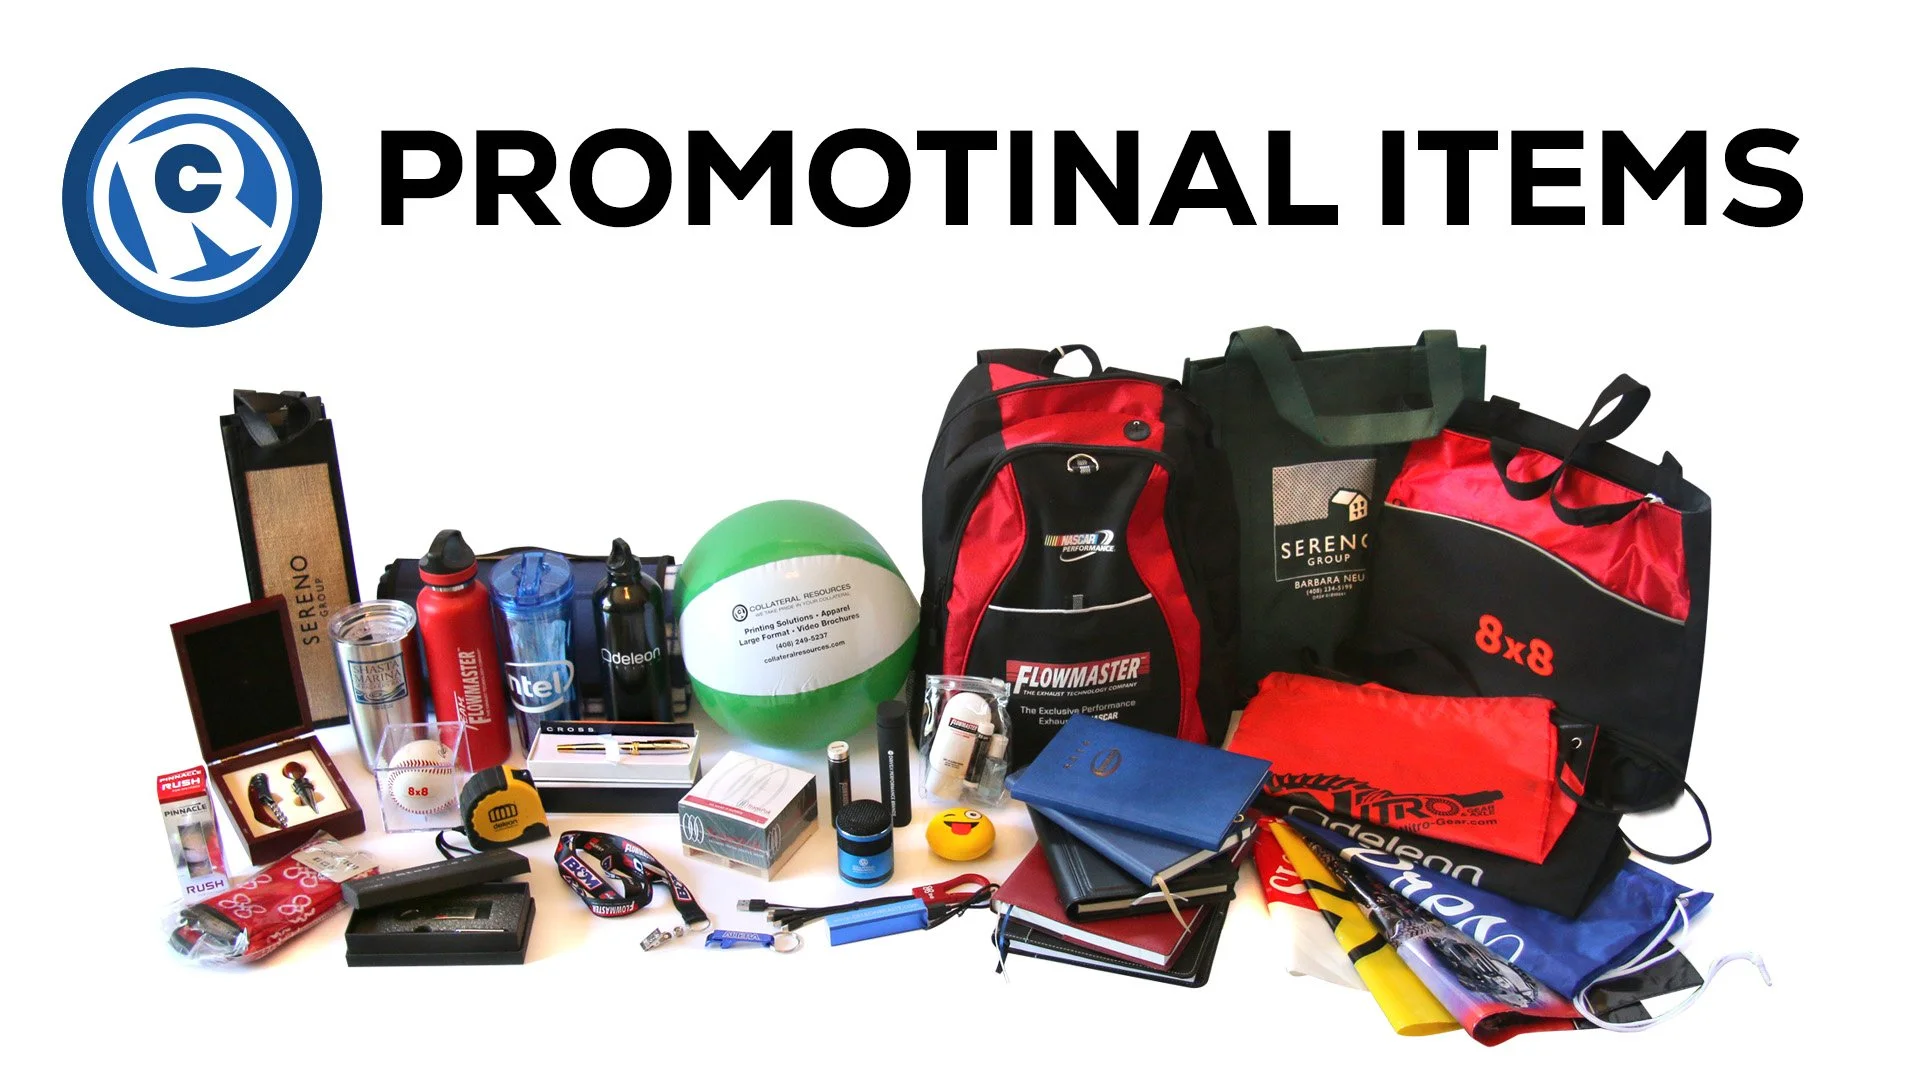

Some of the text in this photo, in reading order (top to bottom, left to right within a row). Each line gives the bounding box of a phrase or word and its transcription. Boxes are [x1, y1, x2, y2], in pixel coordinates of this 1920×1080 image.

[1061, 534, 1097, 546] NASCAR
[1307, 553, 1351, 566] GROUP
[1294, 576, 1340, 589] BARBARA
[290, 555, 320, 645] SERENO
[314, 578, 329, 617] GROUP
[749, 583, 851, 612] COLLATERAL RESOURCES
[744, 604, 851, 635] Printing Solutions Apparel
[739, 613, 860, 647] Large Format Video Brochures
[776, 632, 828, 651] (408) 249-5237
[1475, 613, 1554, 677] 8x8
[764, 639, 846, 664] collateralresources.com
[354, 659, 399, 674] SHASTA
[355, 669, 401, 683] MARINA
[1013, 657, 1141, 694] FLOWMASTER
[458, 651, 491, 725] FLOWMASTER
[1067, 686, 1108, 697] TECHNOLOGY
[1108, 682, 1138, 691] COMPANY
[1020, 699, 1136, 715] The Exclusive Performance
[1092, 711, 1119, 721] ASCAR
[161, 777, 201, 791] RUSH
[408, 787, 429, 796] 8x8
[164, 802, 208, 817] PINNACLE
[562, 858, 601, 889] B&M
[186, 880, 225, 895] RUSH
[592, 900, 635, 915] FLOWMASTER
